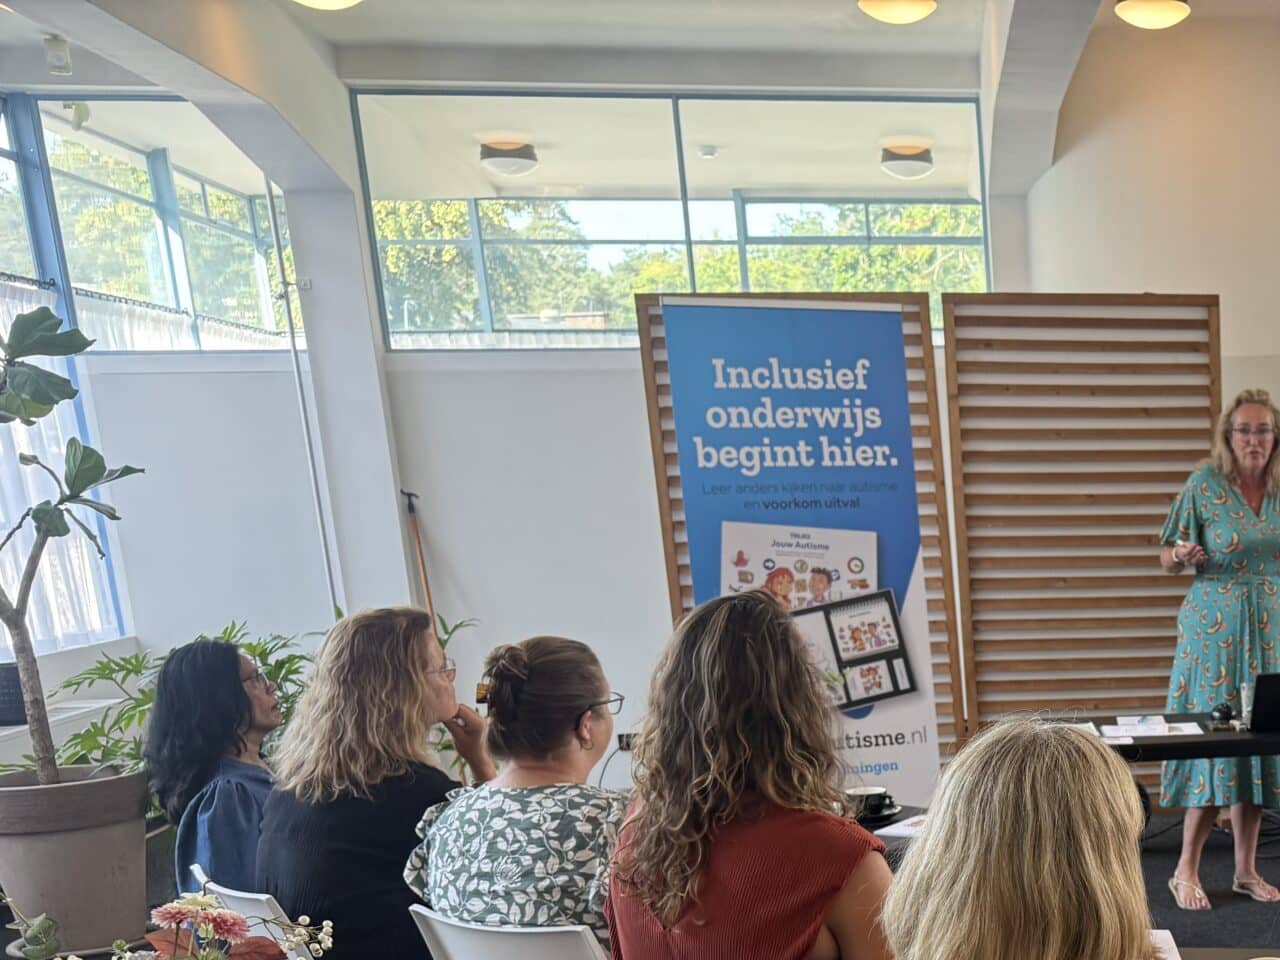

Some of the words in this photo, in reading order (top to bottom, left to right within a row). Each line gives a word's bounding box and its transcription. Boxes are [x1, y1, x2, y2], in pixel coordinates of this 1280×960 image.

[711, 357, 870, 390] Inclusief
[705, 397, 882, 437] onderwijs
[692, 436, 815, 477] begint
[819, 435, 899, 468] hier.
[702, 481, 732, 495] Leer
[735, 481, 780, 494] anders
[762, 498, 822, 510] voorkom
[824, 496, 860, 510] uitval
[832, 725, 928, 750] utisme.nl
